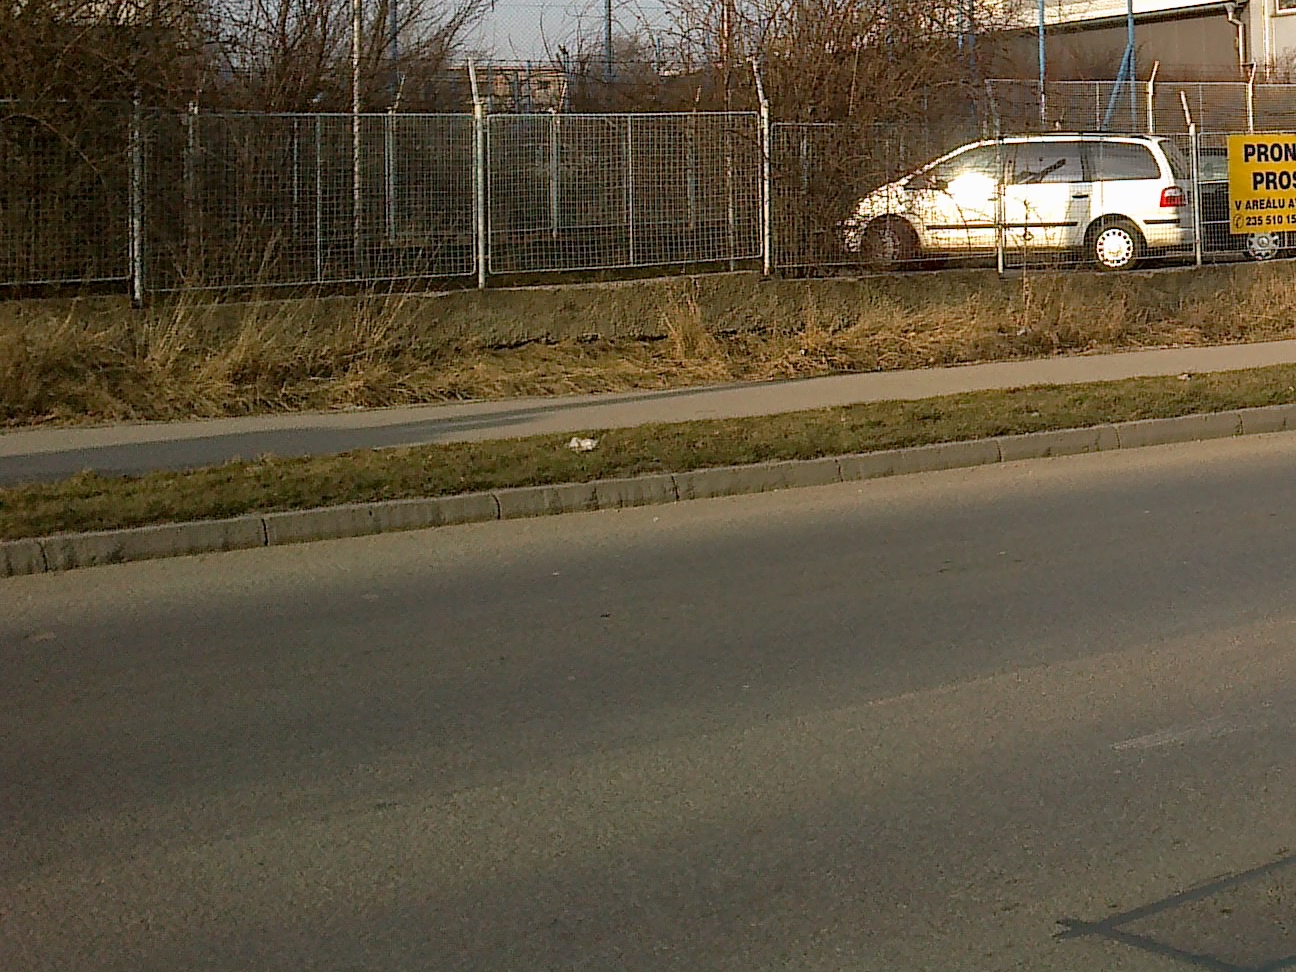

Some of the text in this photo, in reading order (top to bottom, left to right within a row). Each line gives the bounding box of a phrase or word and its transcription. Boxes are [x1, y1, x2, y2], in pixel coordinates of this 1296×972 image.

[1234, 200, 1242, 211] V
[1245, 197, 1286, 210] AREÁLU
[1245, 216, 1263, 226] 235
[1265, 214, 1283, 225] 510
